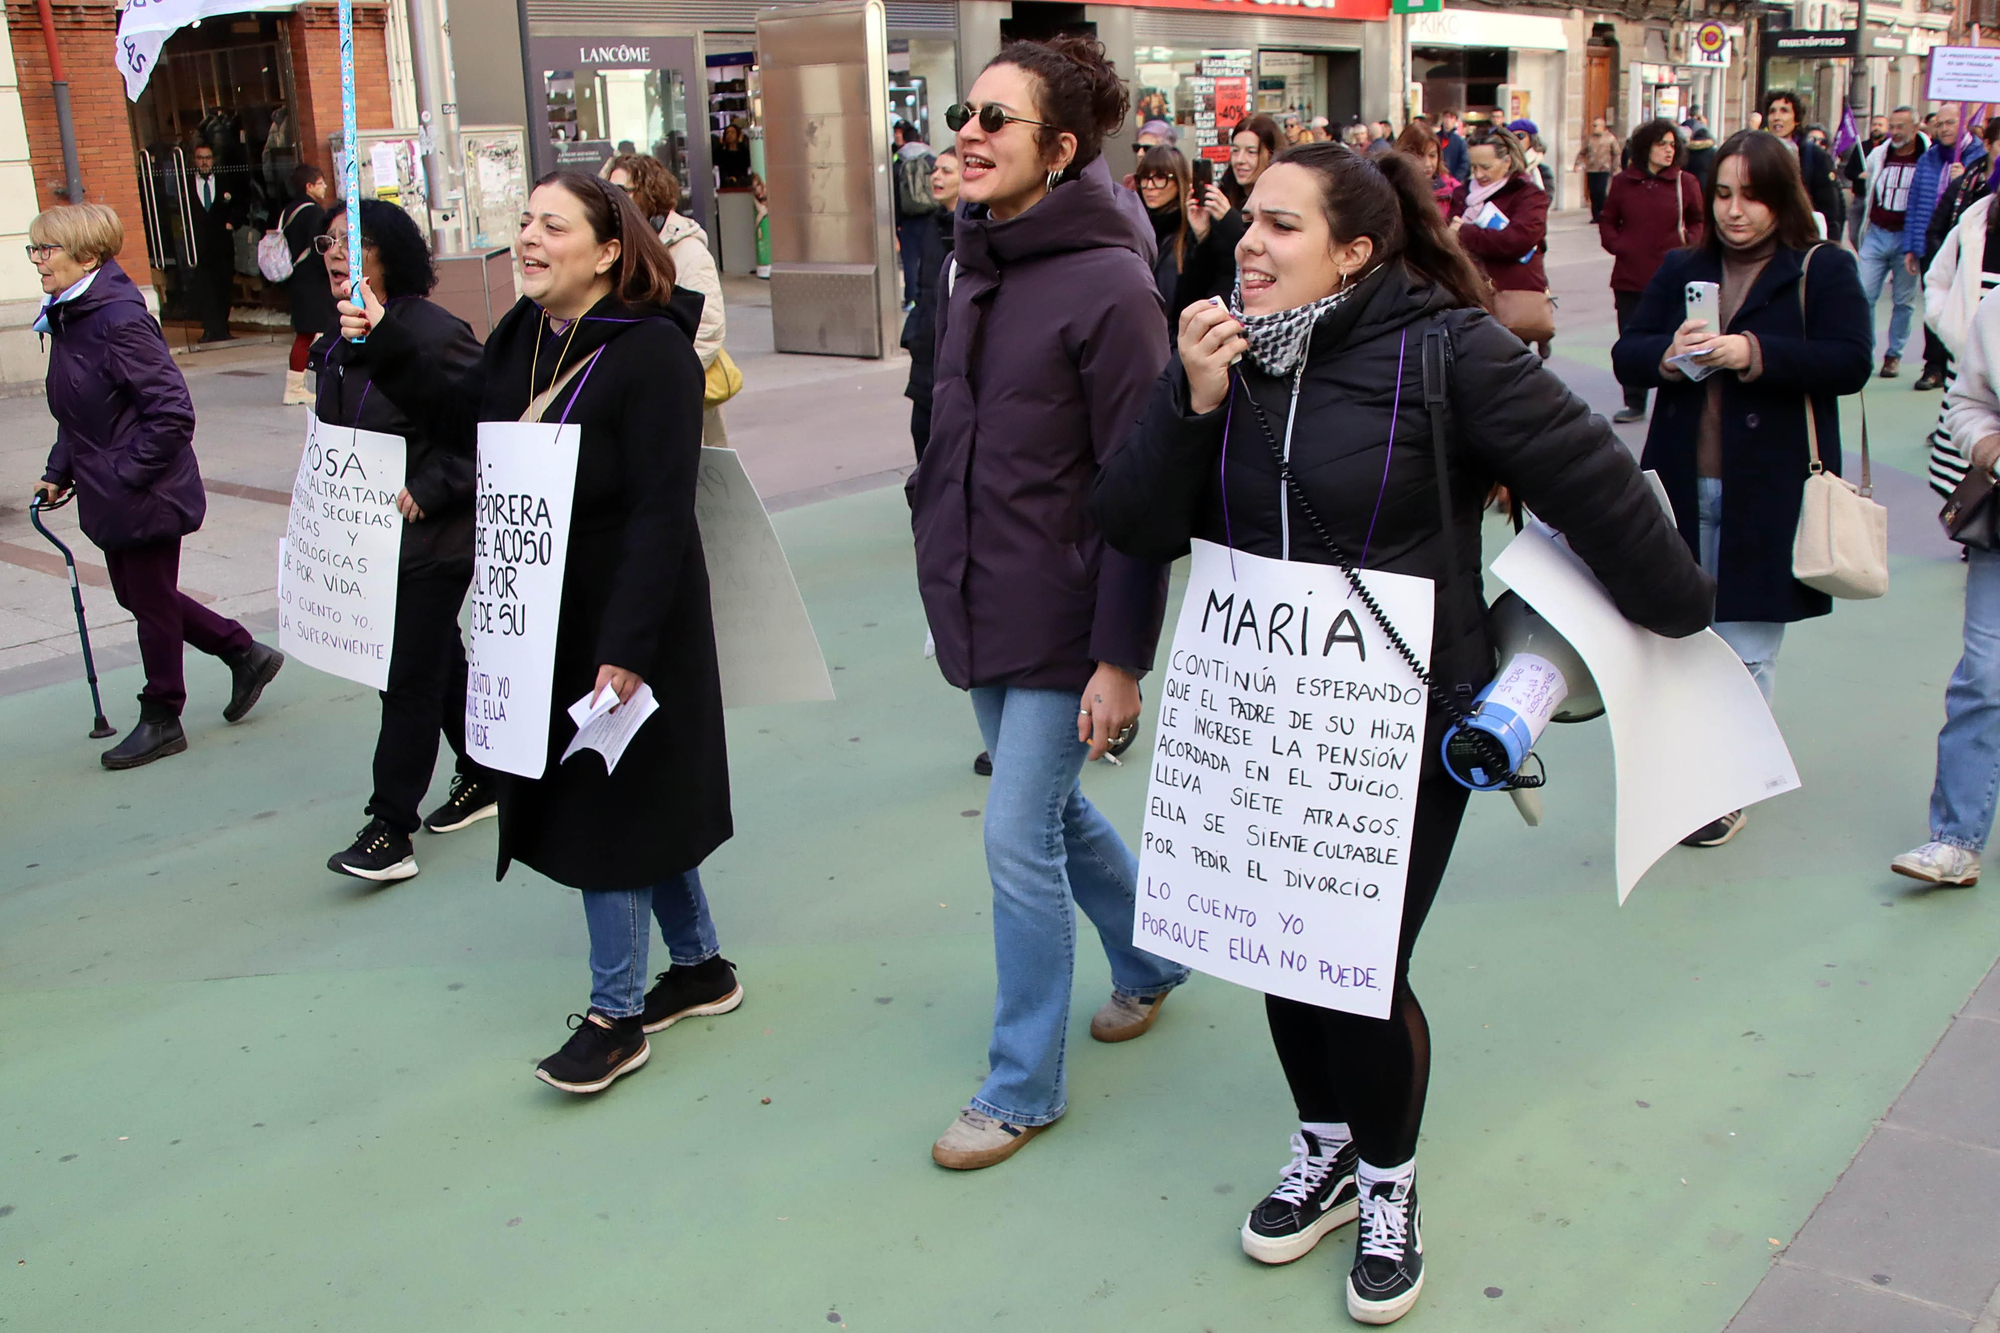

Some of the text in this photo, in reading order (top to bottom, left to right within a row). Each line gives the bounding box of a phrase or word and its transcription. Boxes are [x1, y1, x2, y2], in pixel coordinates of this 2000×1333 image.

[1420, 13, 1459, 34] KIKO
[580, 44, 650, 63] LANCÔME
[1219, 105, 1245, 120] -40%
[322, 502, 394, 529] SECUELAS
[347, 530, 358, 546] Y
[493, 528, 551, 566] ACOSO
[284, 551, 292, 571] DE
[297, 560, 315, 583] POR
[489, 565, 518, 600] POR
[281, 583, 292, 604] LO
[299, 597, 342, 623] CUENTO
[480, 602, 494, 633] DE
[499, 603, 525, 636] SU
[281, 612, 291, 631] LA
[497, 676, 510, 699] YO
[1172, 650, 1421, 705] CONTINÚA ESPERANDO
[484, 699, 507, 721] ELLA
[1167, 679, 1415, 743] QUE EL PADRE DE SU HIJA
[1162, 705, 1408, 770] LE INGRESE LA PENSIÓN
[1158, 734, 1231, 773] ACORDADA
[1245, 760, 1269, 782] EN
[1289, 768, 1312, 789] EL
[1155, 763, 1401, 838] LLEVA SIETE ATRASOS.
[1151, 796, 1399, 866] ELLA SE SIENTE CULPABLE
[1144, 832, 1176, 858] POR
[1191, 846, 1231, 873] PEDIR
[1248, 859, 1268, 882] EL
[1147, 876, 1304, 935] LO CUENTO YO
[1142, 912, 1381, 991] PORQUE ELLA NO PUEDE.
